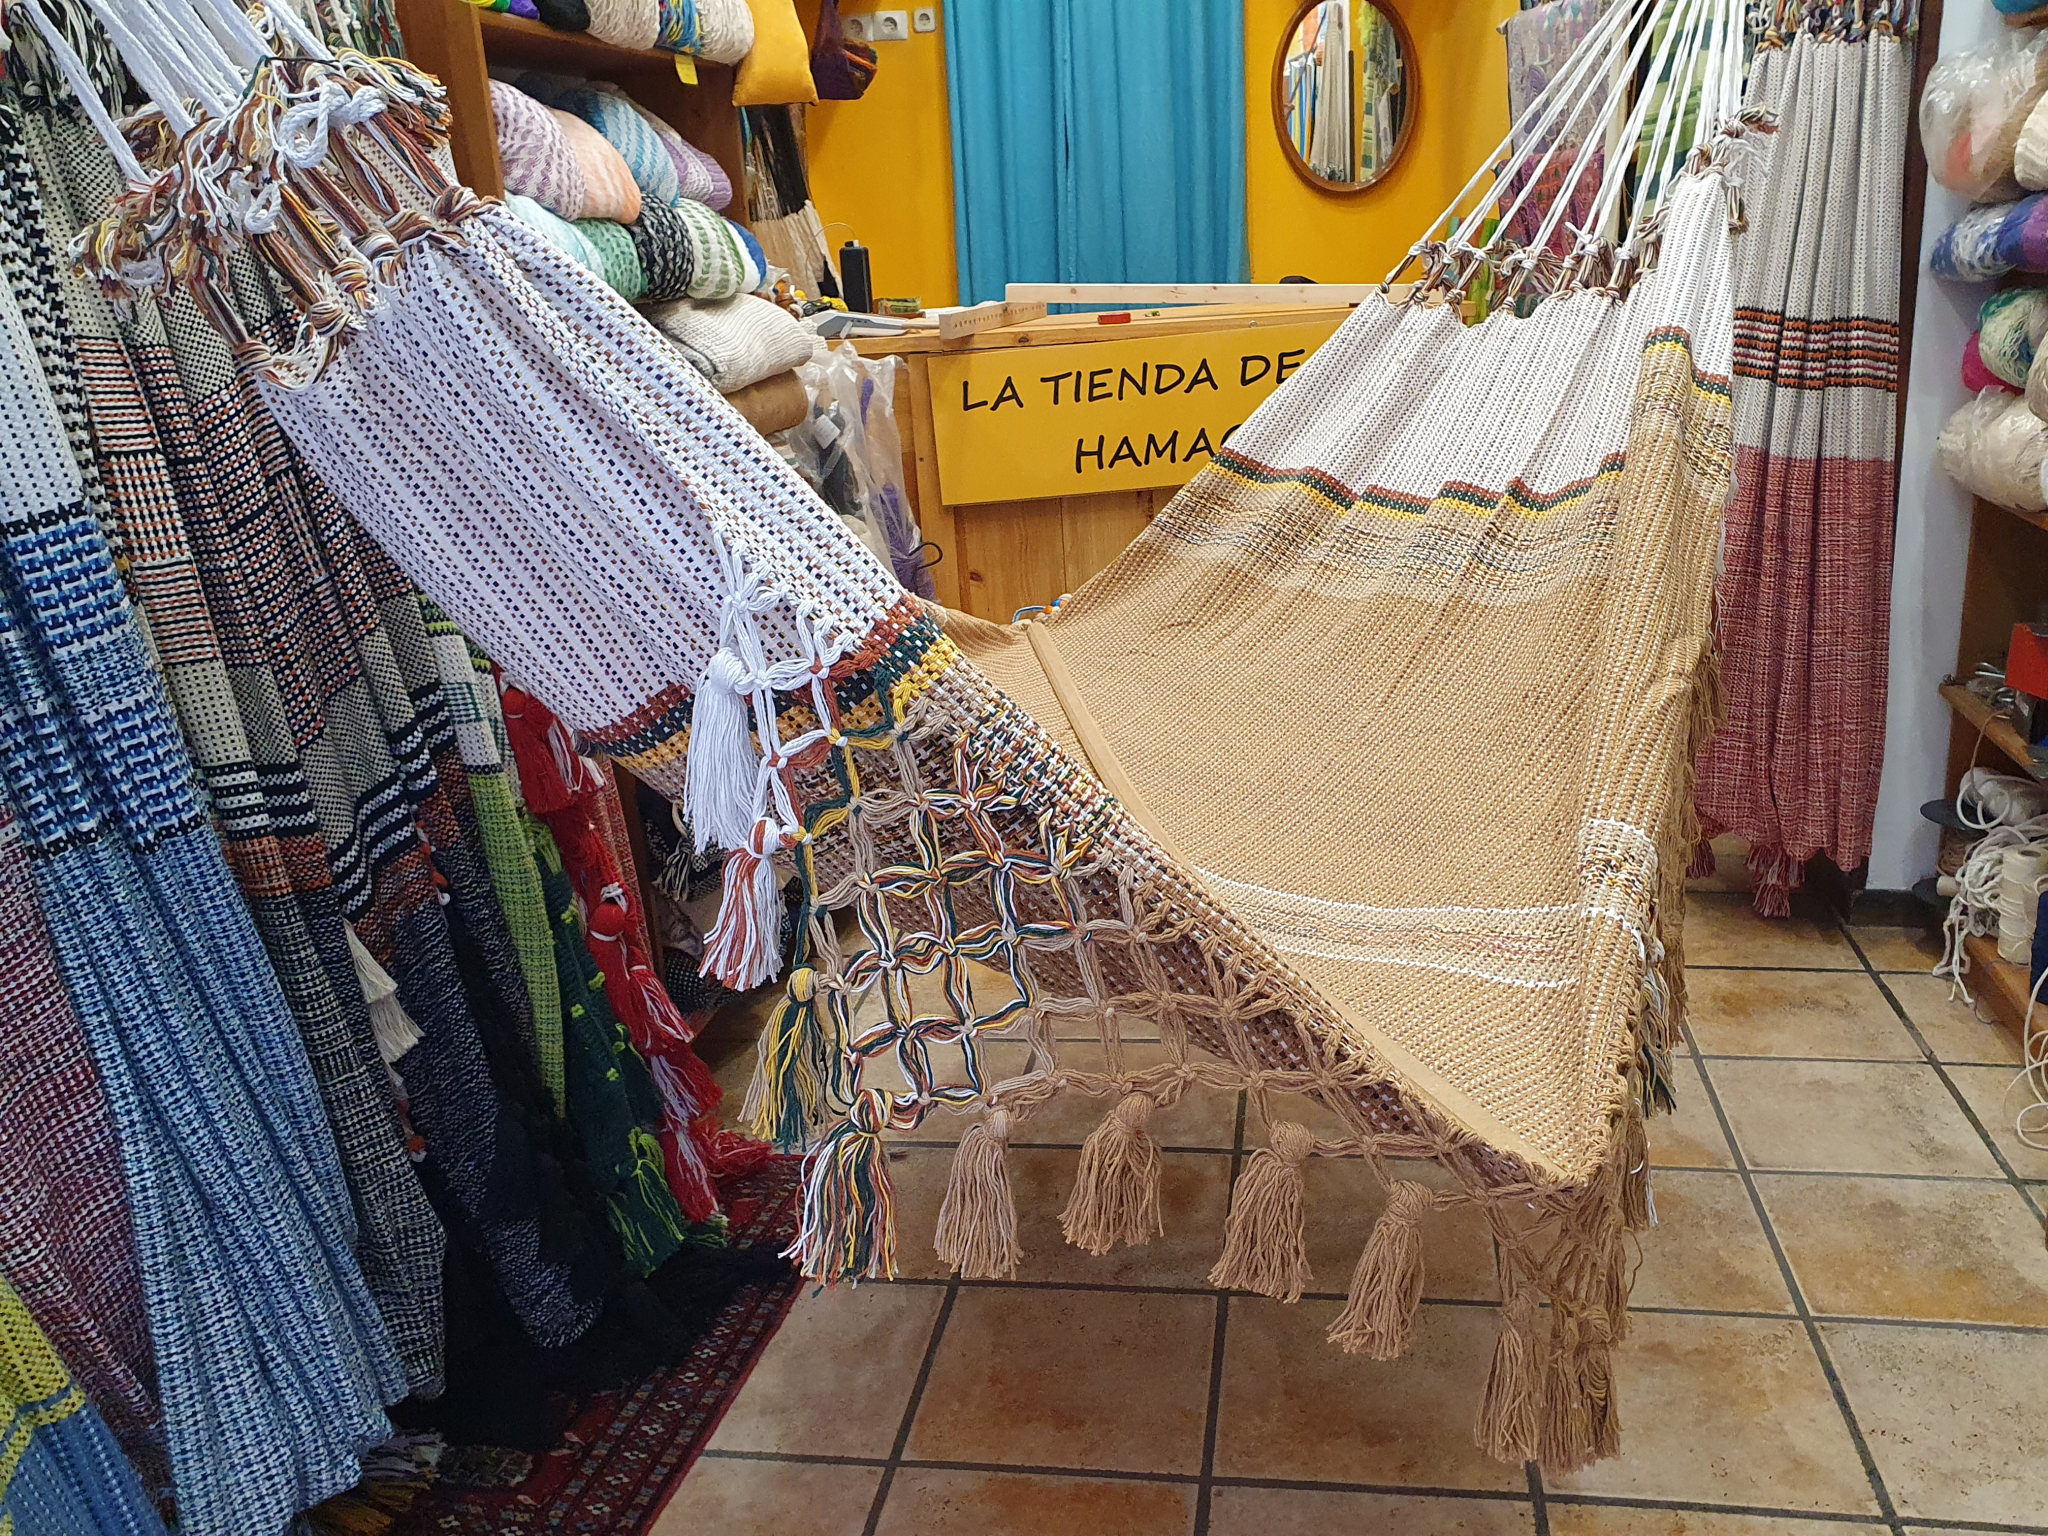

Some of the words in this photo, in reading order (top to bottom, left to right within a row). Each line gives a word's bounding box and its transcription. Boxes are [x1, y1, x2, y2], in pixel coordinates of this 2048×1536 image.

[961, 375, 1024, 412] LA
[1040, 357, 1219, 405] TIENDA
[1240, 348, 1306, 387] DE
